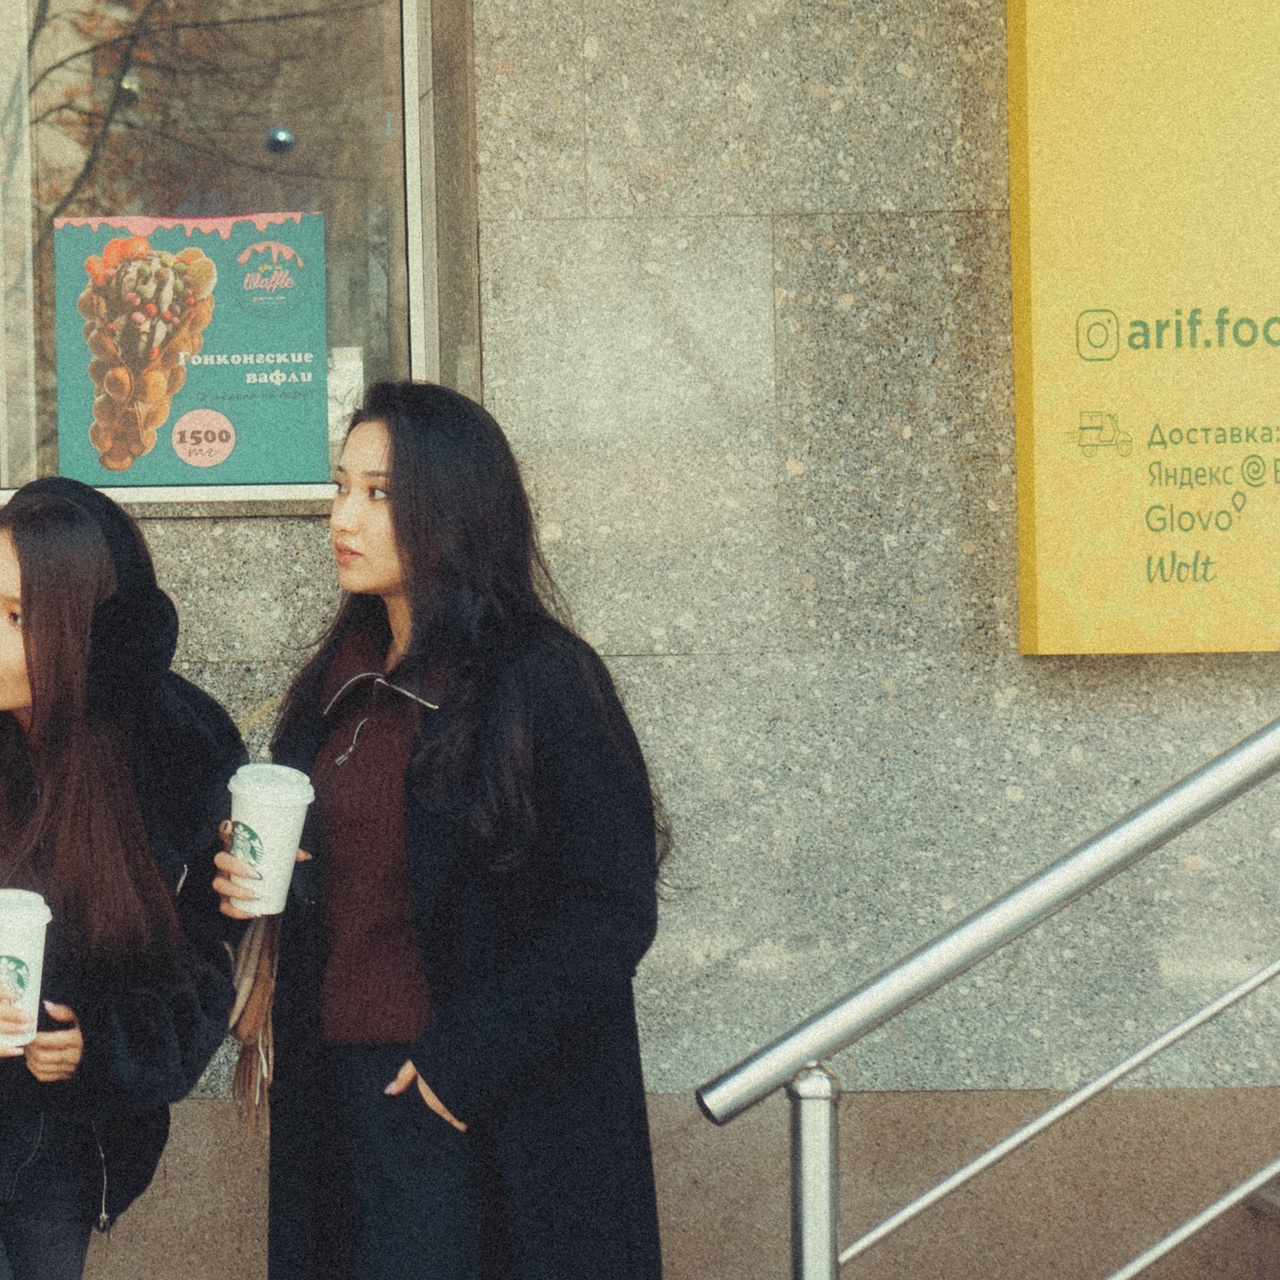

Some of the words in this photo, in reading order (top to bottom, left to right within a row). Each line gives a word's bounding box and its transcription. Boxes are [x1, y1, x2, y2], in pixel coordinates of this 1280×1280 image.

[177, 351, 314, 366] Гонконгские
[245, 369, 313, 386] вафли
[176, 429, 232, 446] 1500
[1148, 460, 1234, 490] Яндекс
[1145, 503, 1234, 533] Glovo
[1145, 549, 1218, 584] Wolt
